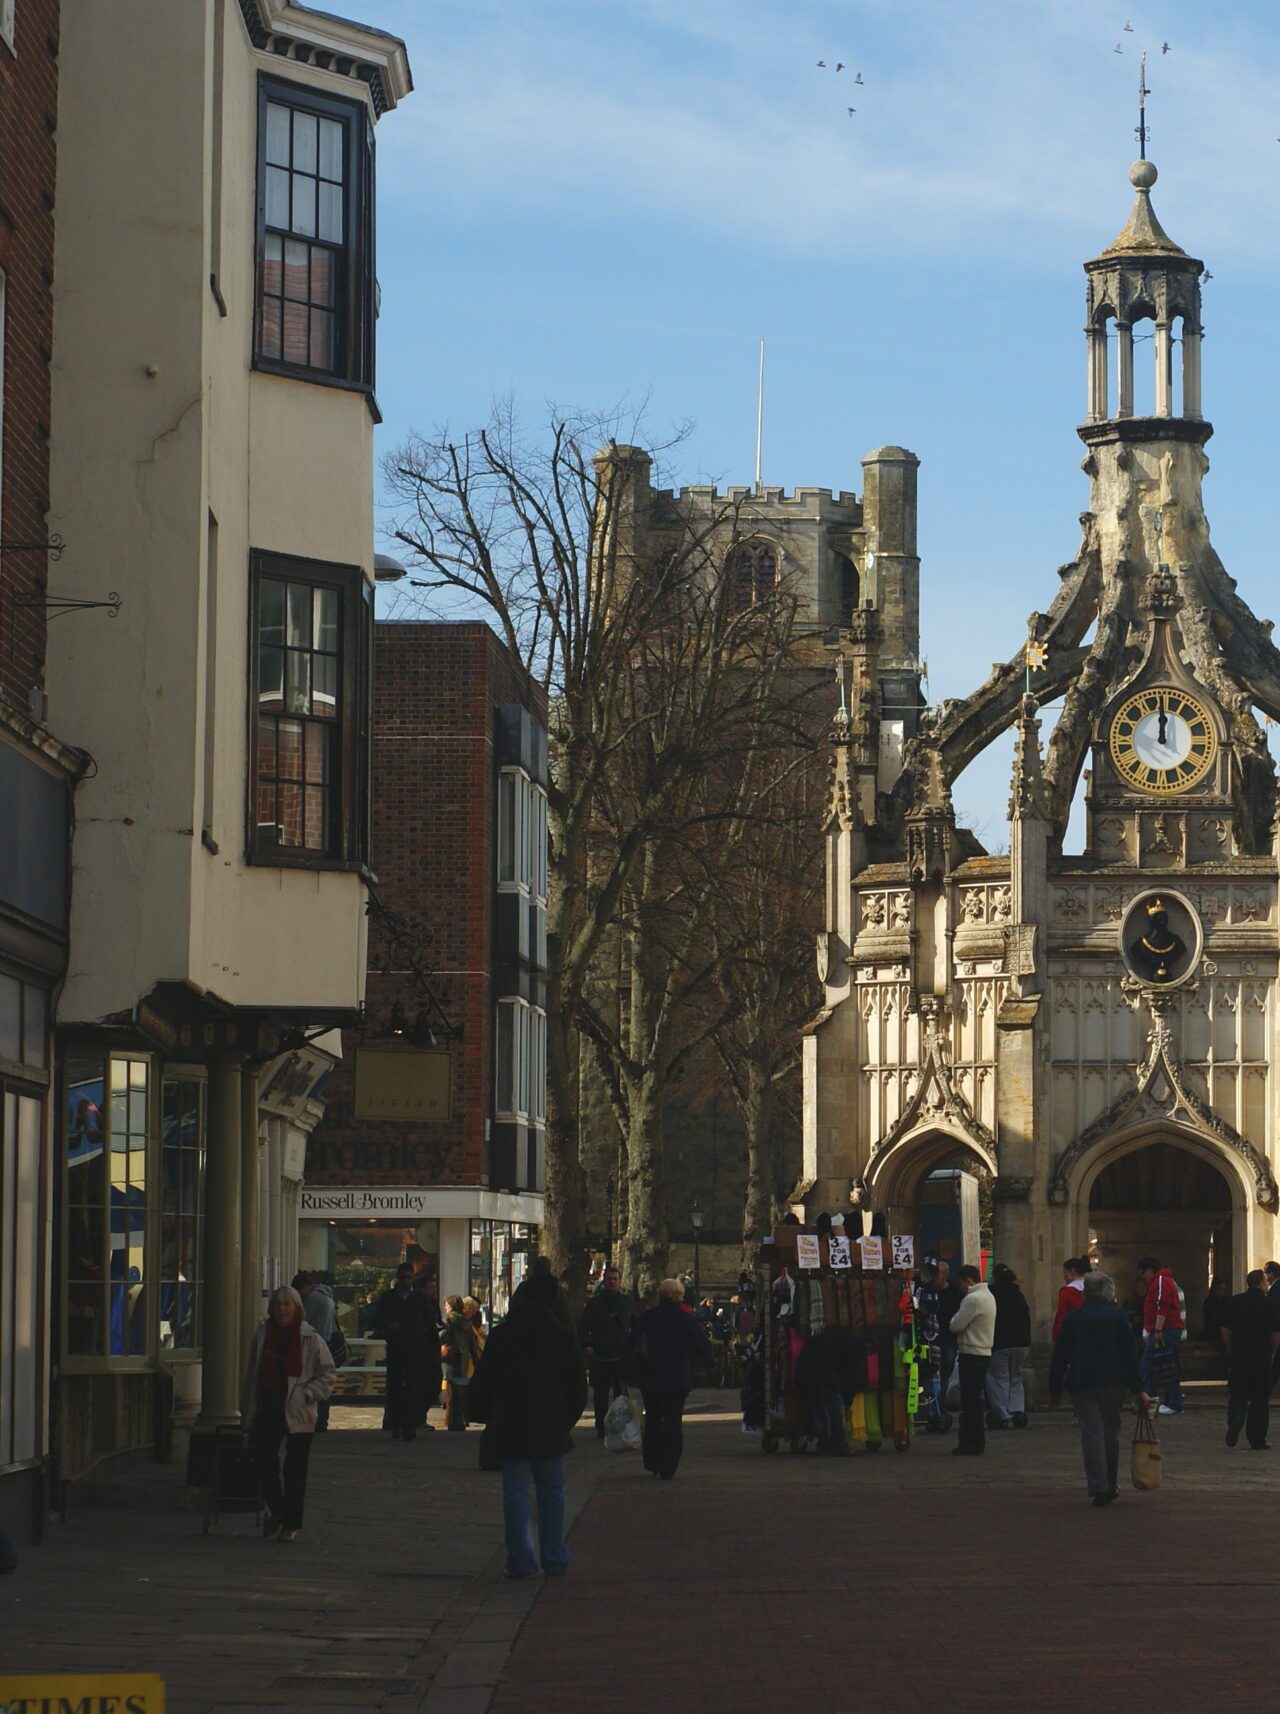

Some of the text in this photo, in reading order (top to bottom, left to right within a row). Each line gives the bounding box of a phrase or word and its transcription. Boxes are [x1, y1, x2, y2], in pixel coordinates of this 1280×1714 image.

[367, 1096, 438, 1109] JIGSAW
[301, 1193, 354, 1209] Russell
[363, 1193, 426, 1212] Bromley
[830, 1238, 839, 1248] 3
[893, 1237, 903, 1247] 3
[9, 1695, 147, 1714] TIMES
